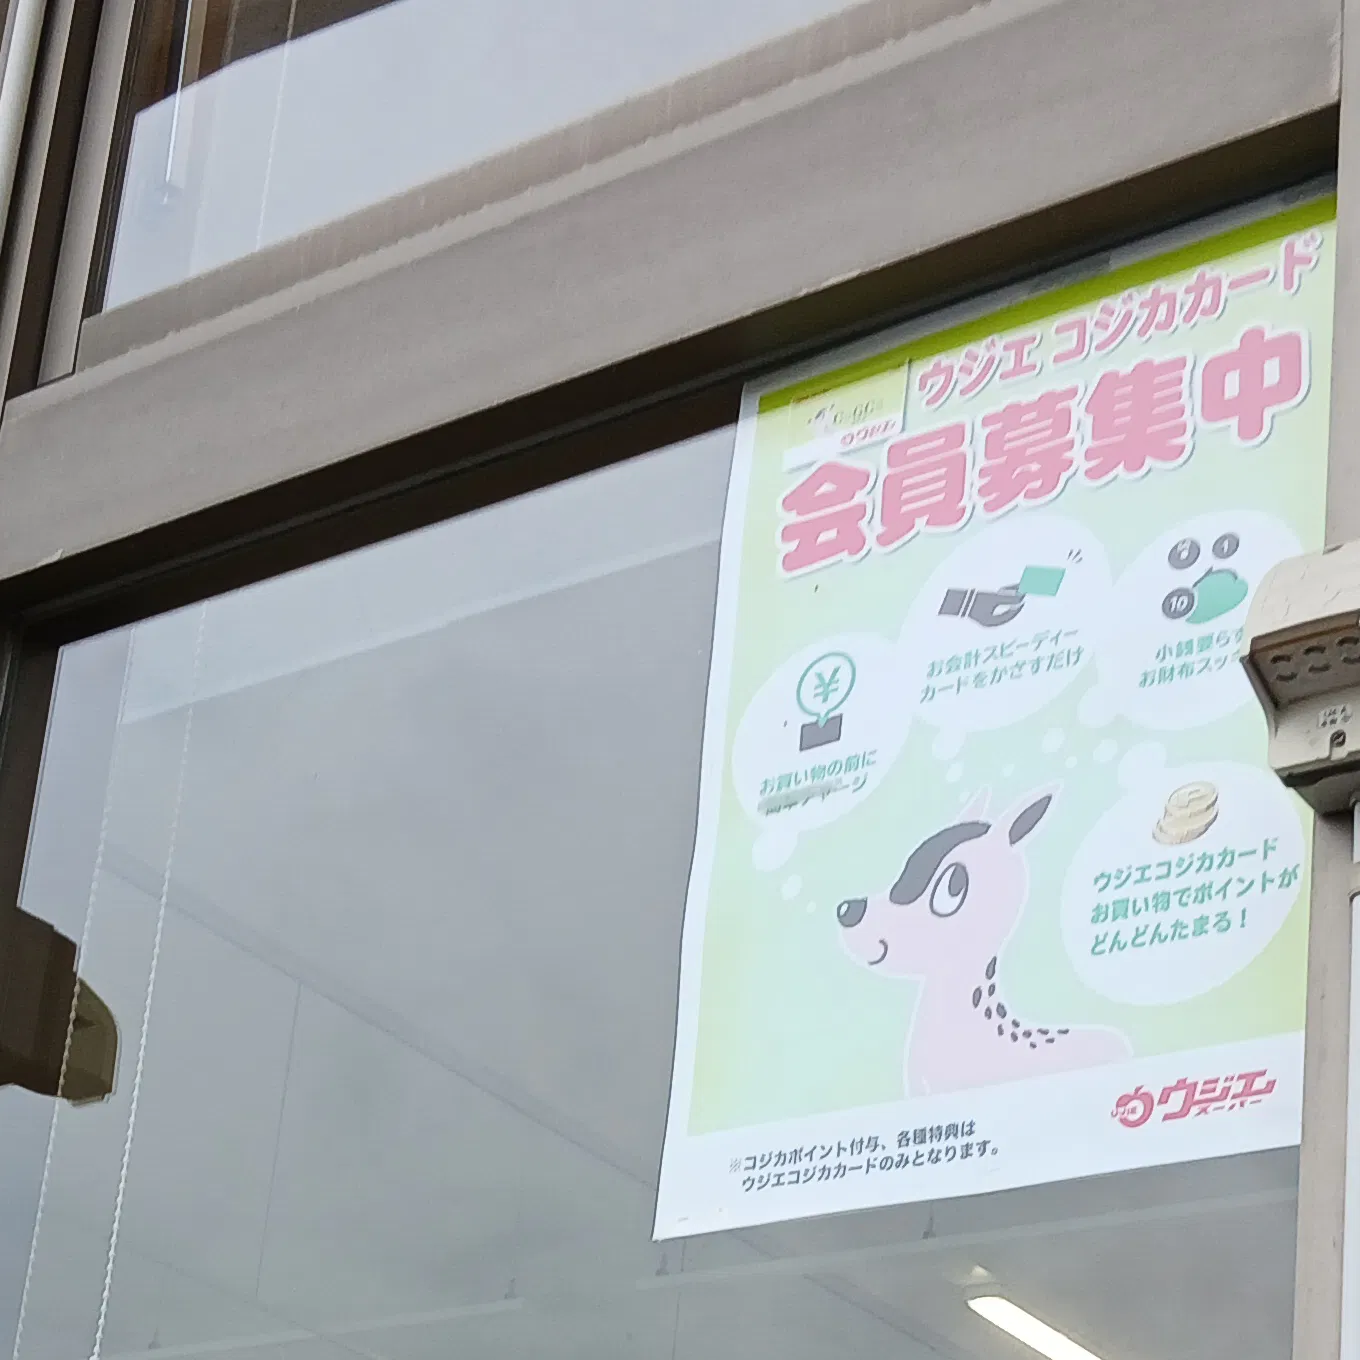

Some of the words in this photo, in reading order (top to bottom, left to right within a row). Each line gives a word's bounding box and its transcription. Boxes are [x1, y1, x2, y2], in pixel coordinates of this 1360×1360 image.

[917, 332, 1039, 408] ウジエ
[1052, 232, 1322, 364] コジカカード
[779, 326, 1303, 573] 会員募集中
[920, 646, 1084, 704] カードをかざすだけ
[926, 629, 1079, 679] お会計スピーディー
[1093, 836, 1279, 893] ウジエコジカカード
[1090, 864, 1300, 924] お買い物でポイントが
[1157, 1068, 1278, 1123] ウジエ
[741, 1139, 1000, 1193] ウジエコジカカードのみとなります。
